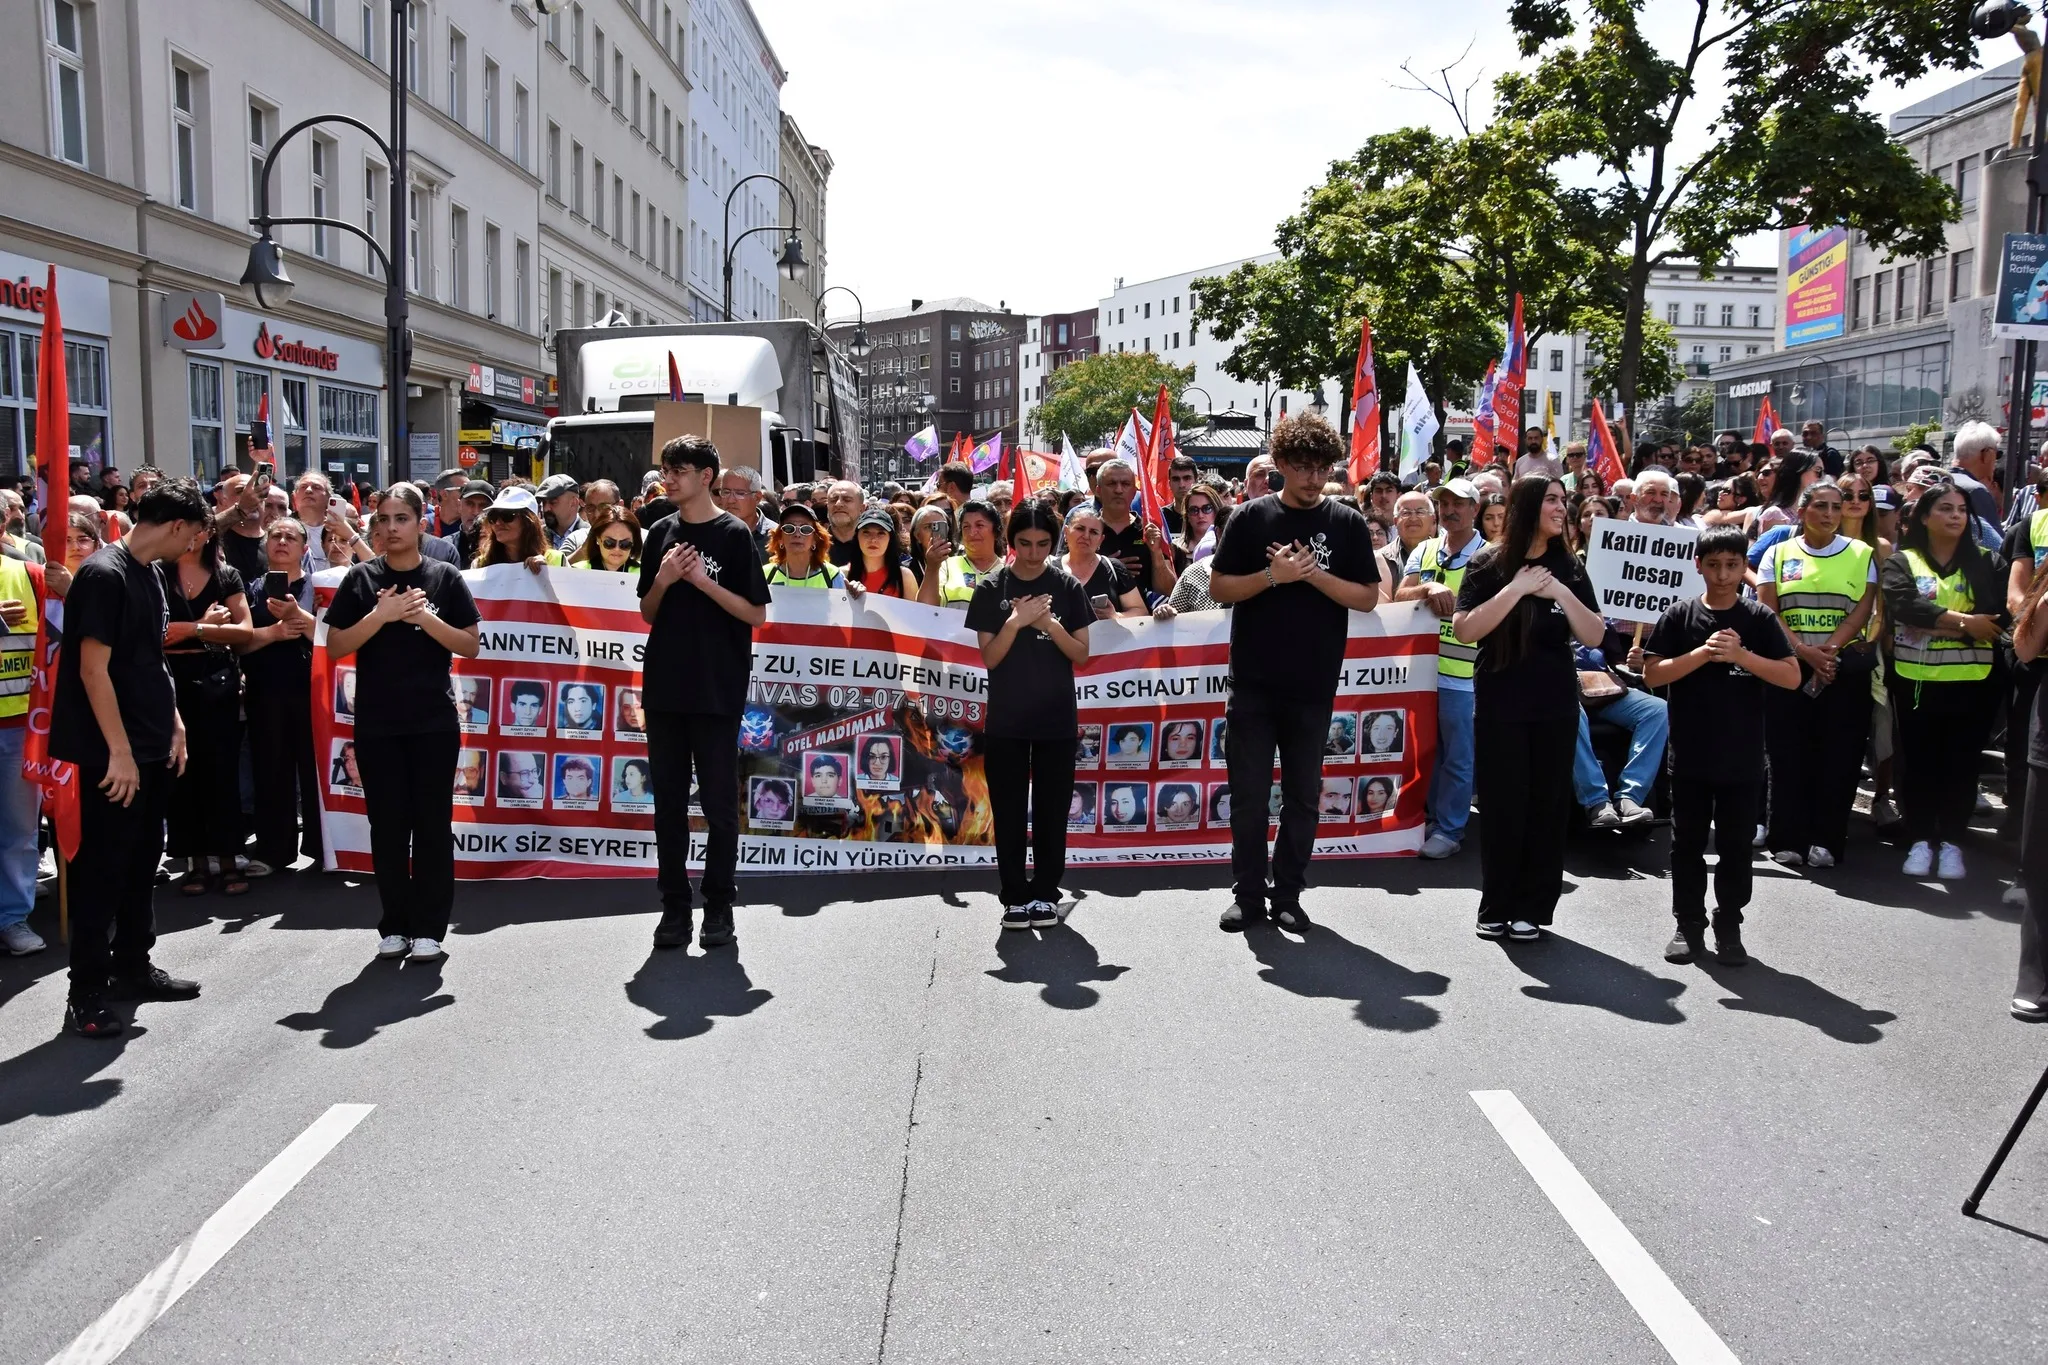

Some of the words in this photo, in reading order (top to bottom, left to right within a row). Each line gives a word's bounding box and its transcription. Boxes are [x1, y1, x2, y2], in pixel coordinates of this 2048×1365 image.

[2010, 253, 2037, 262] keine
[2011, 240, 2046, 251] Füttere
[1798, 254, 1834, 284] GÜNSTIG!
[2009, 263, 2040, 274] Ratten
[273, 334, 339, 371] Santander
[469, 368, 480, 388] ria
[609, 378, 721, 391] LOGISICS
[1729, 379, 1772, 398] KARSTADT
[460, 448, 476, 459] ria
[1601, 530, 1648, 555] Katil
[1621, 560, 1684, 589] hesap
[587, 640, 624, 661] IHR
[764, 654, 801, 677] ZU,
[809, 657, 845, 677] SIE
[853, 660, 942, 688] LAUFEN
[949, 671, 989, 695] FÜR
[1106, 677, 1199, 700] SCHAUT
[1356, 666, 1408, 686] ZU!!!
[828, 685, 981, 722] 02-07-1993
[787, 738, 812, 754] OTEL
[815, 711, 887, 746] MADIMAK
[515, 830, 552, 853] SİZ
[793, 843, 838, 868] İÇİN
